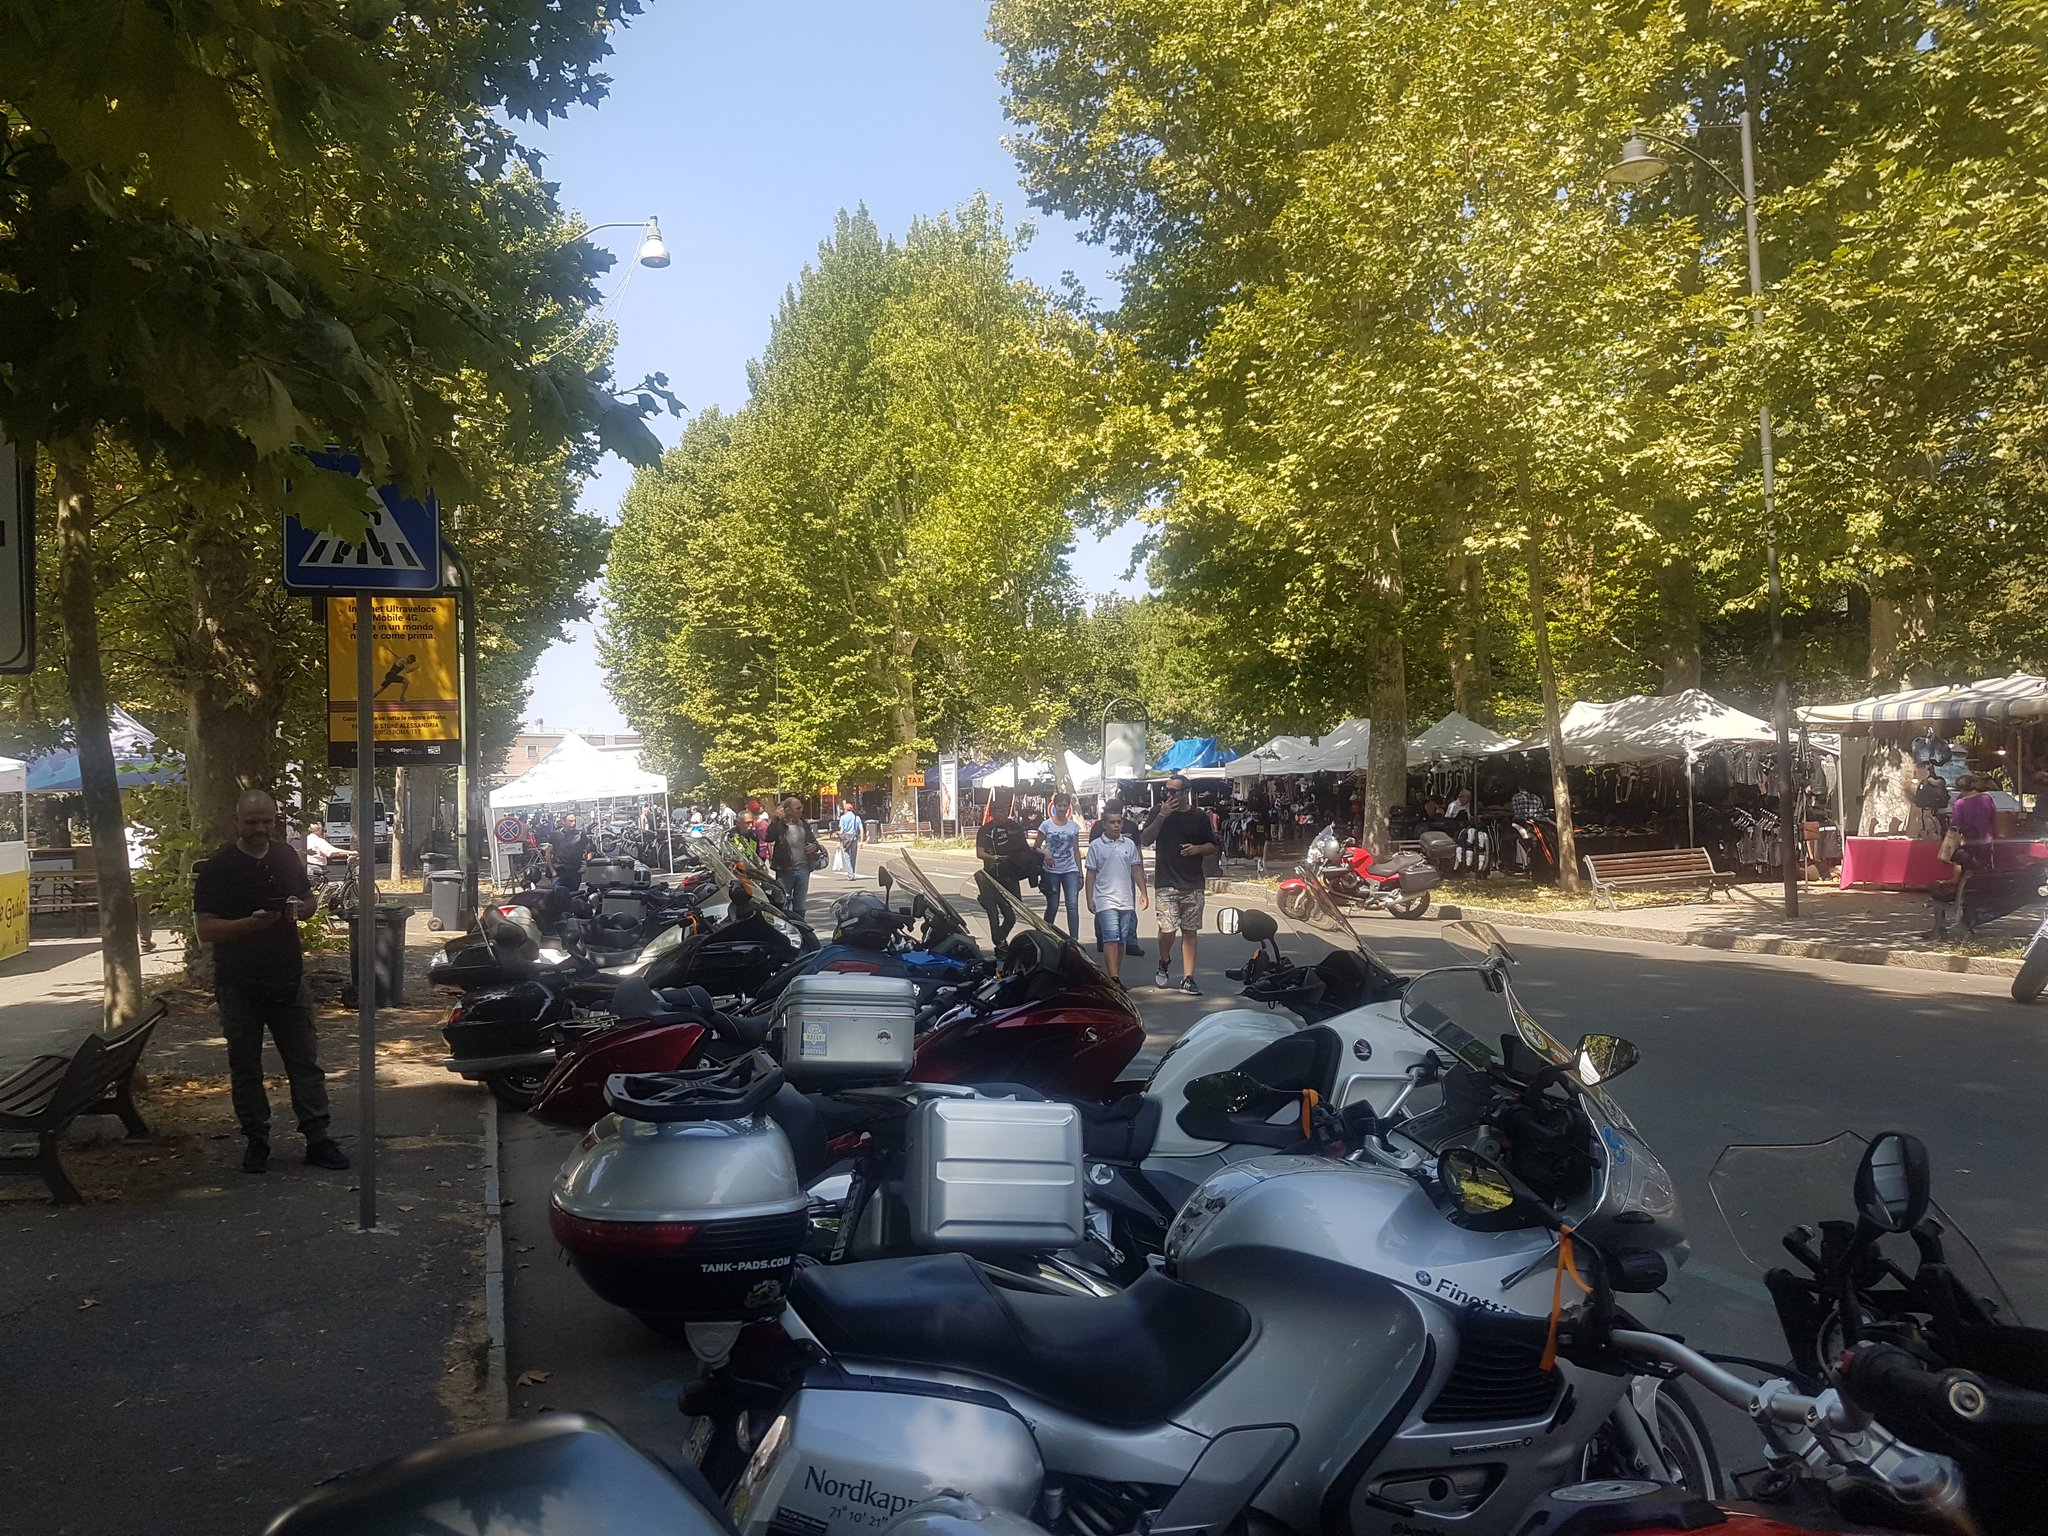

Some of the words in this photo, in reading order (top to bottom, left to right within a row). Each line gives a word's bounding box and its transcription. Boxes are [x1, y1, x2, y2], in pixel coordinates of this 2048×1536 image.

[348, 604, 383, 613] Innet
[386, 604, 437, 613] Ultraveloce
[372, 613, 404, 622] Mobile
[389, 623, 401, 631] un
[402, 622, 434, 631] mondo
[380, 632, 406, 640] come
[407, 631, 437, 641] prima.
[700, 1255, 792, 1273] TANK-PADS.COM
[804, 1465, 919, 1517] Nordkap
